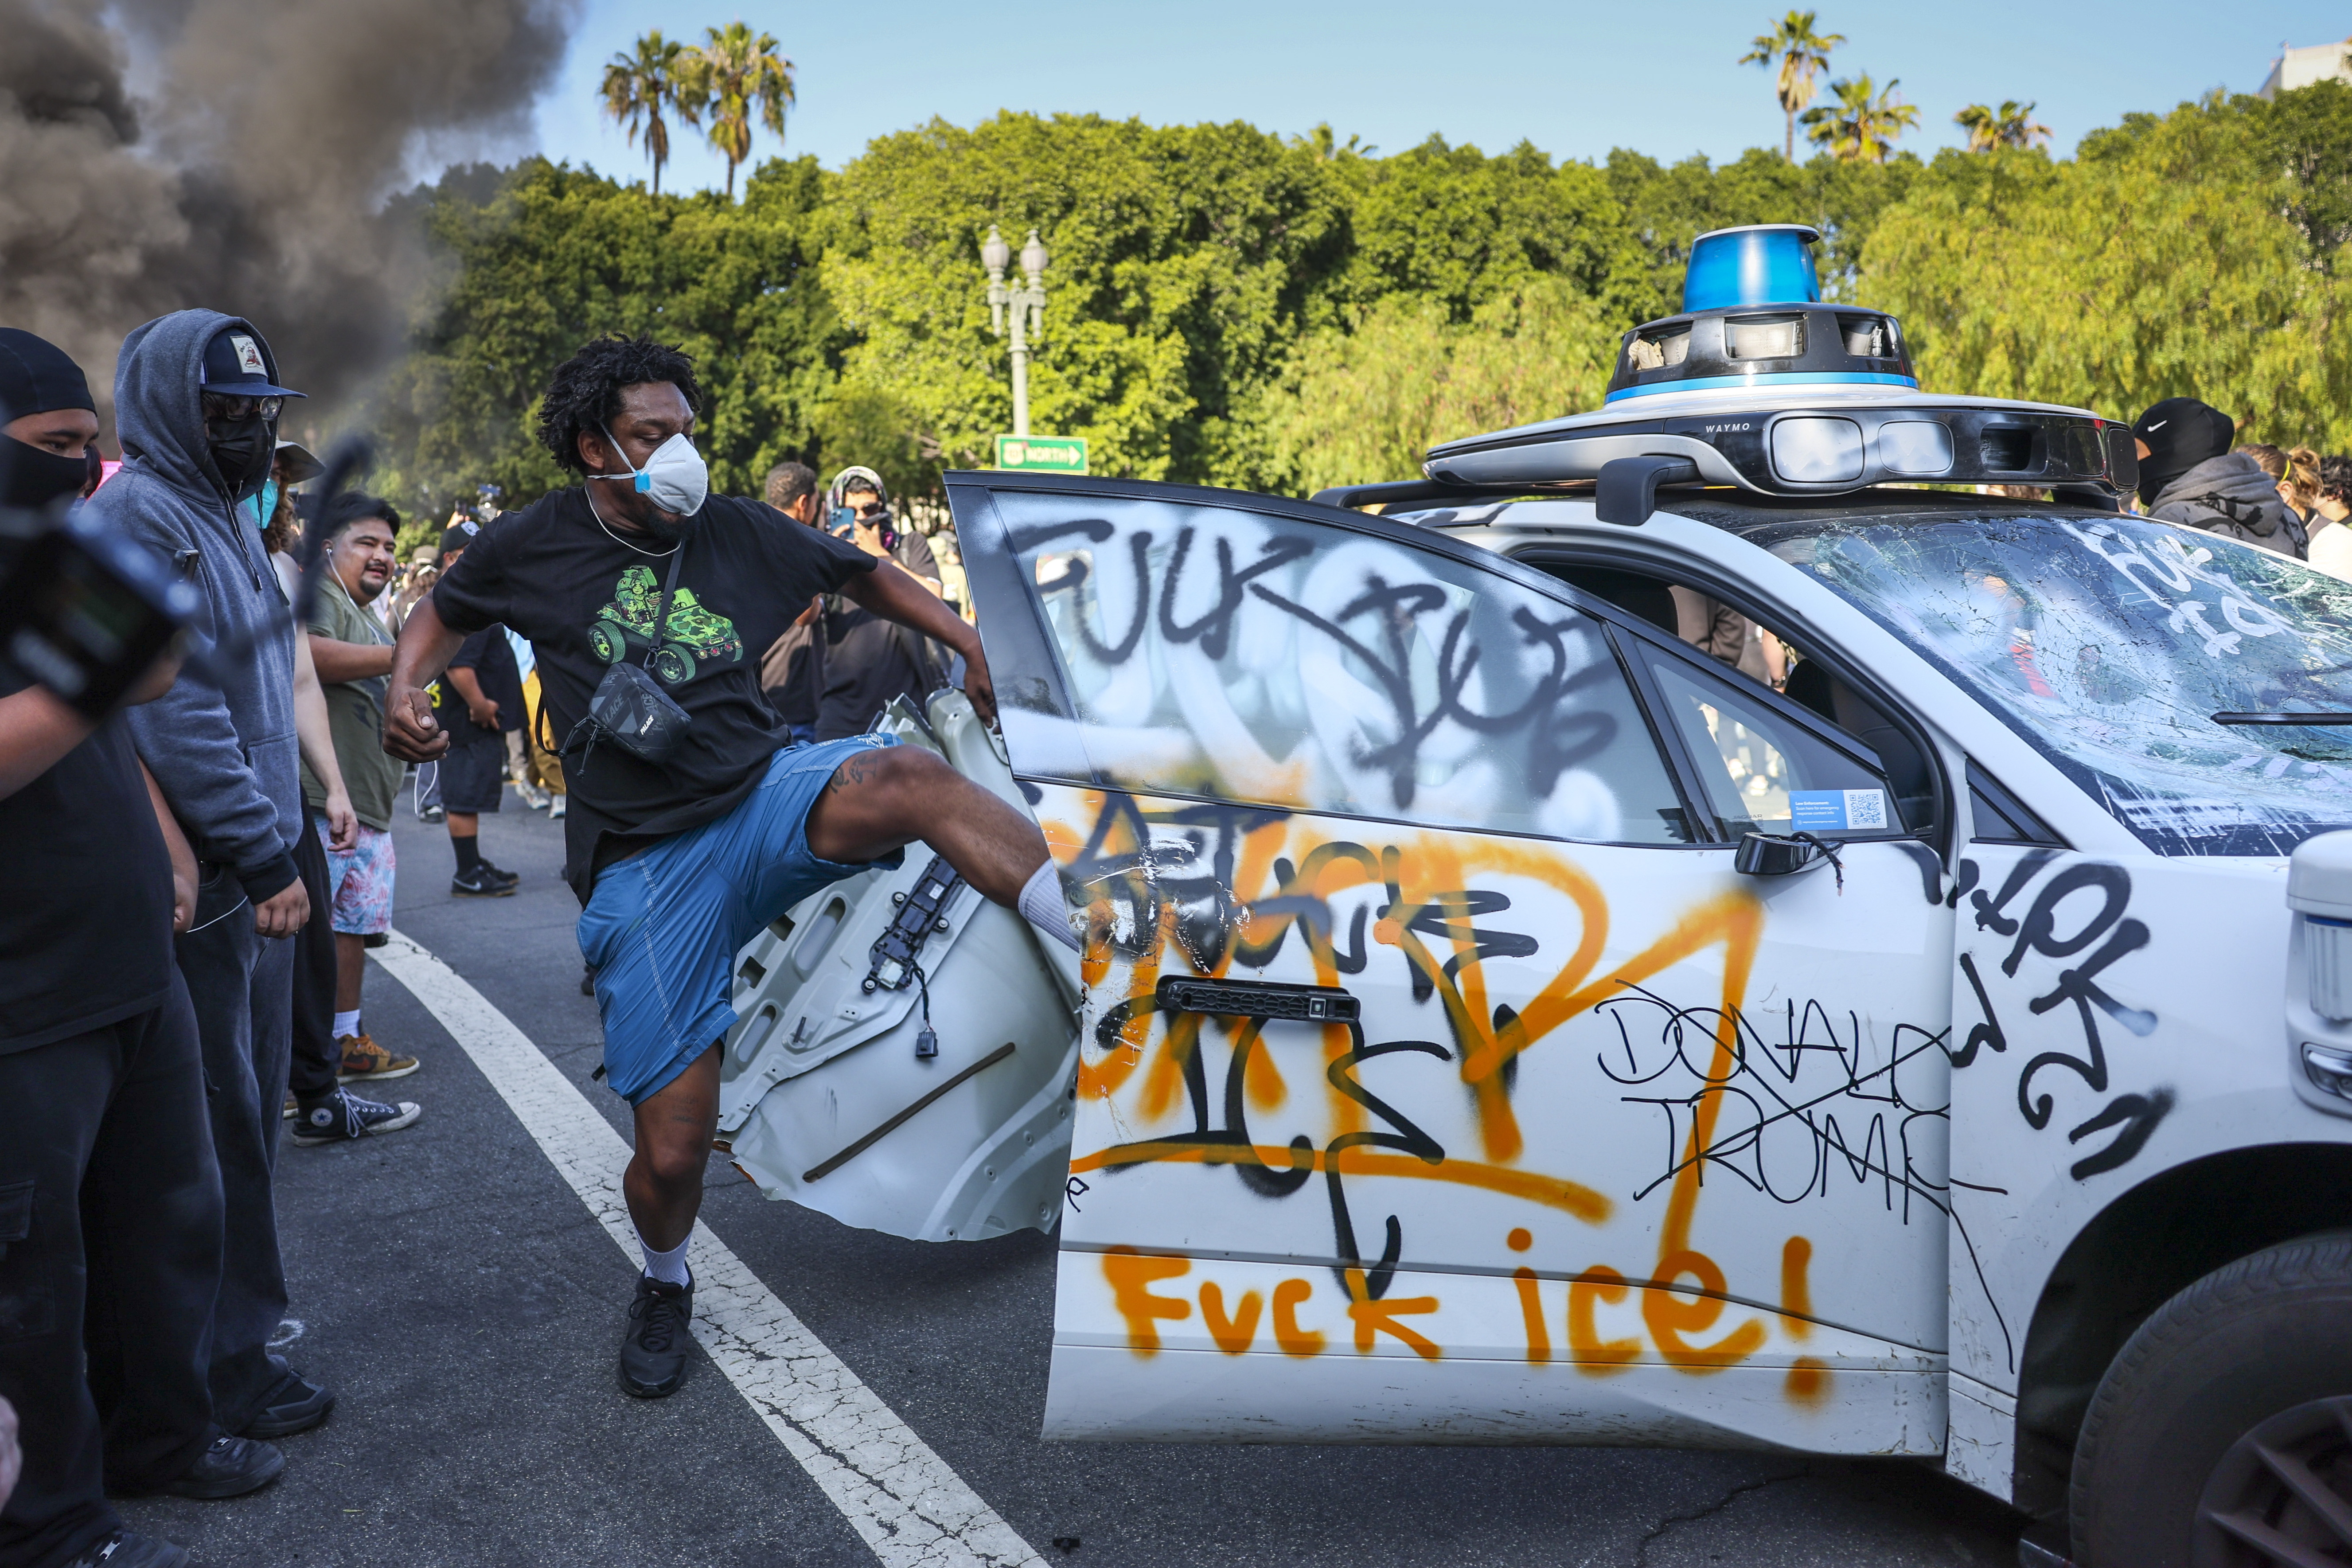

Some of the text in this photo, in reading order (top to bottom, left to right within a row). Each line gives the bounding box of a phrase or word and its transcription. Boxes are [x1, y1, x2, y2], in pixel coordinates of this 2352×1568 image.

[1706, 423, 1750, 433] WAYMO
[640, 714, 654, 735] PALACE
[1595, 996, 1951, 1113] DONALD
